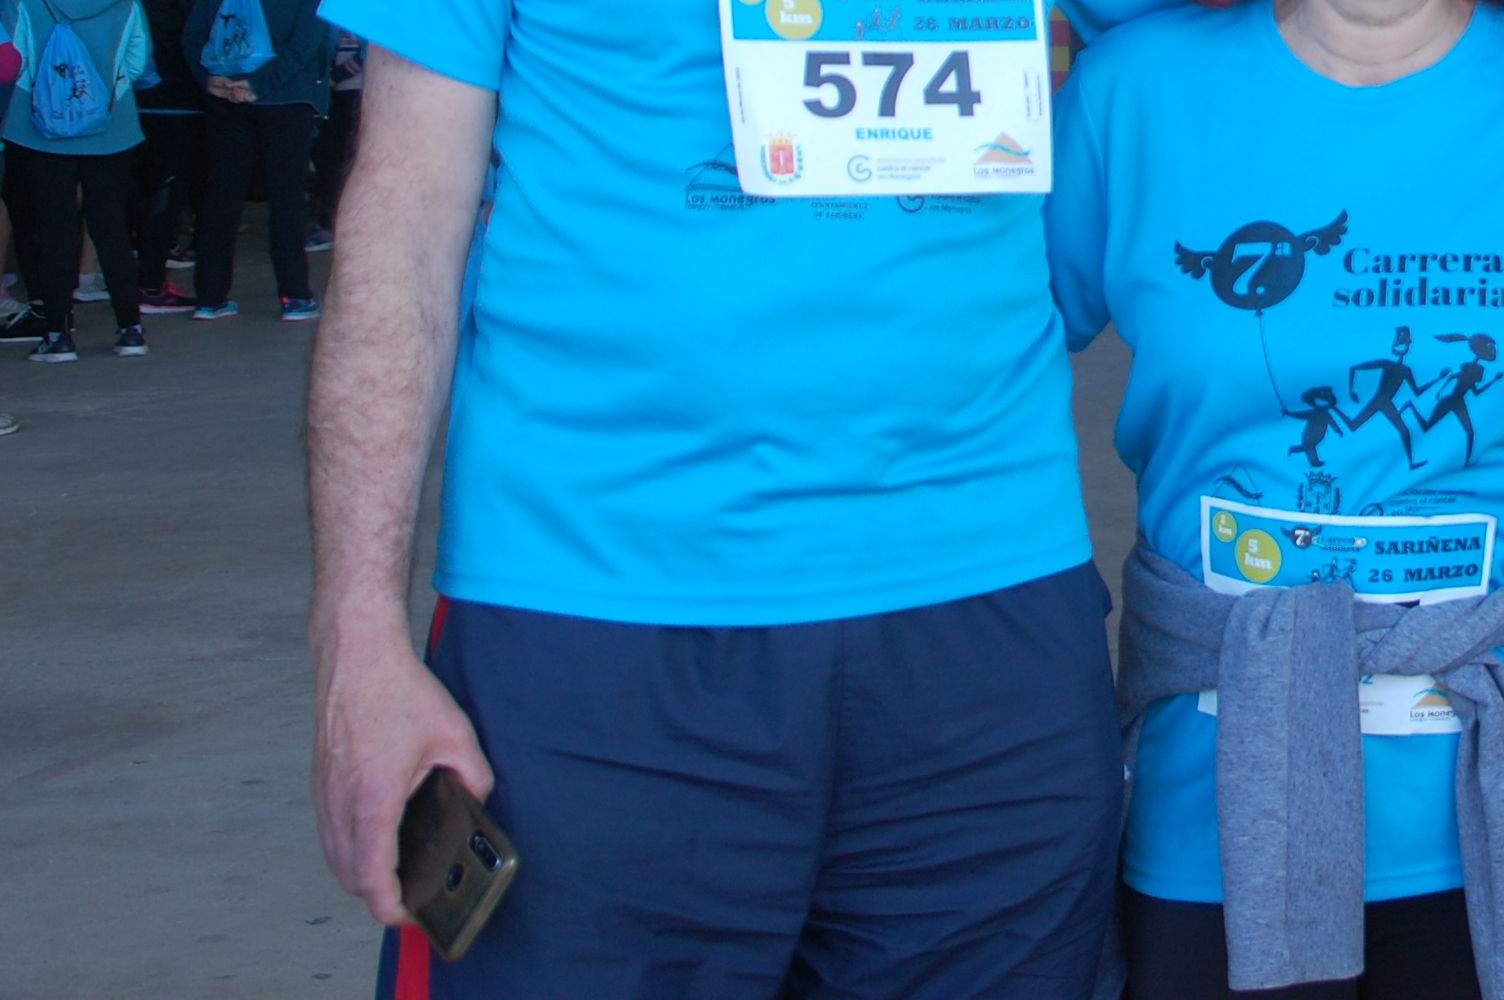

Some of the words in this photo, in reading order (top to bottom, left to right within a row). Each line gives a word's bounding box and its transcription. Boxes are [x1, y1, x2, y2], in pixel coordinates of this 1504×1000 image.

[779, 11, 813, 24] km
[913, 16, 939, 32] 26
[948, 16, 1030, 32] MARZO
[802, 50, 982, 118] 574
[855, 127, 933, 142] ENRIQUE
[1343, 247, 1504, 275] Carrera
[1247, 538, 1258, 552] 5
[1374, 536, 1482, 556] SARIÑENA
[1243, 553, 1273, 570] km
[1368, 568, 1394, 583] 26
[1403, 563, 1480, 583] MARZO
